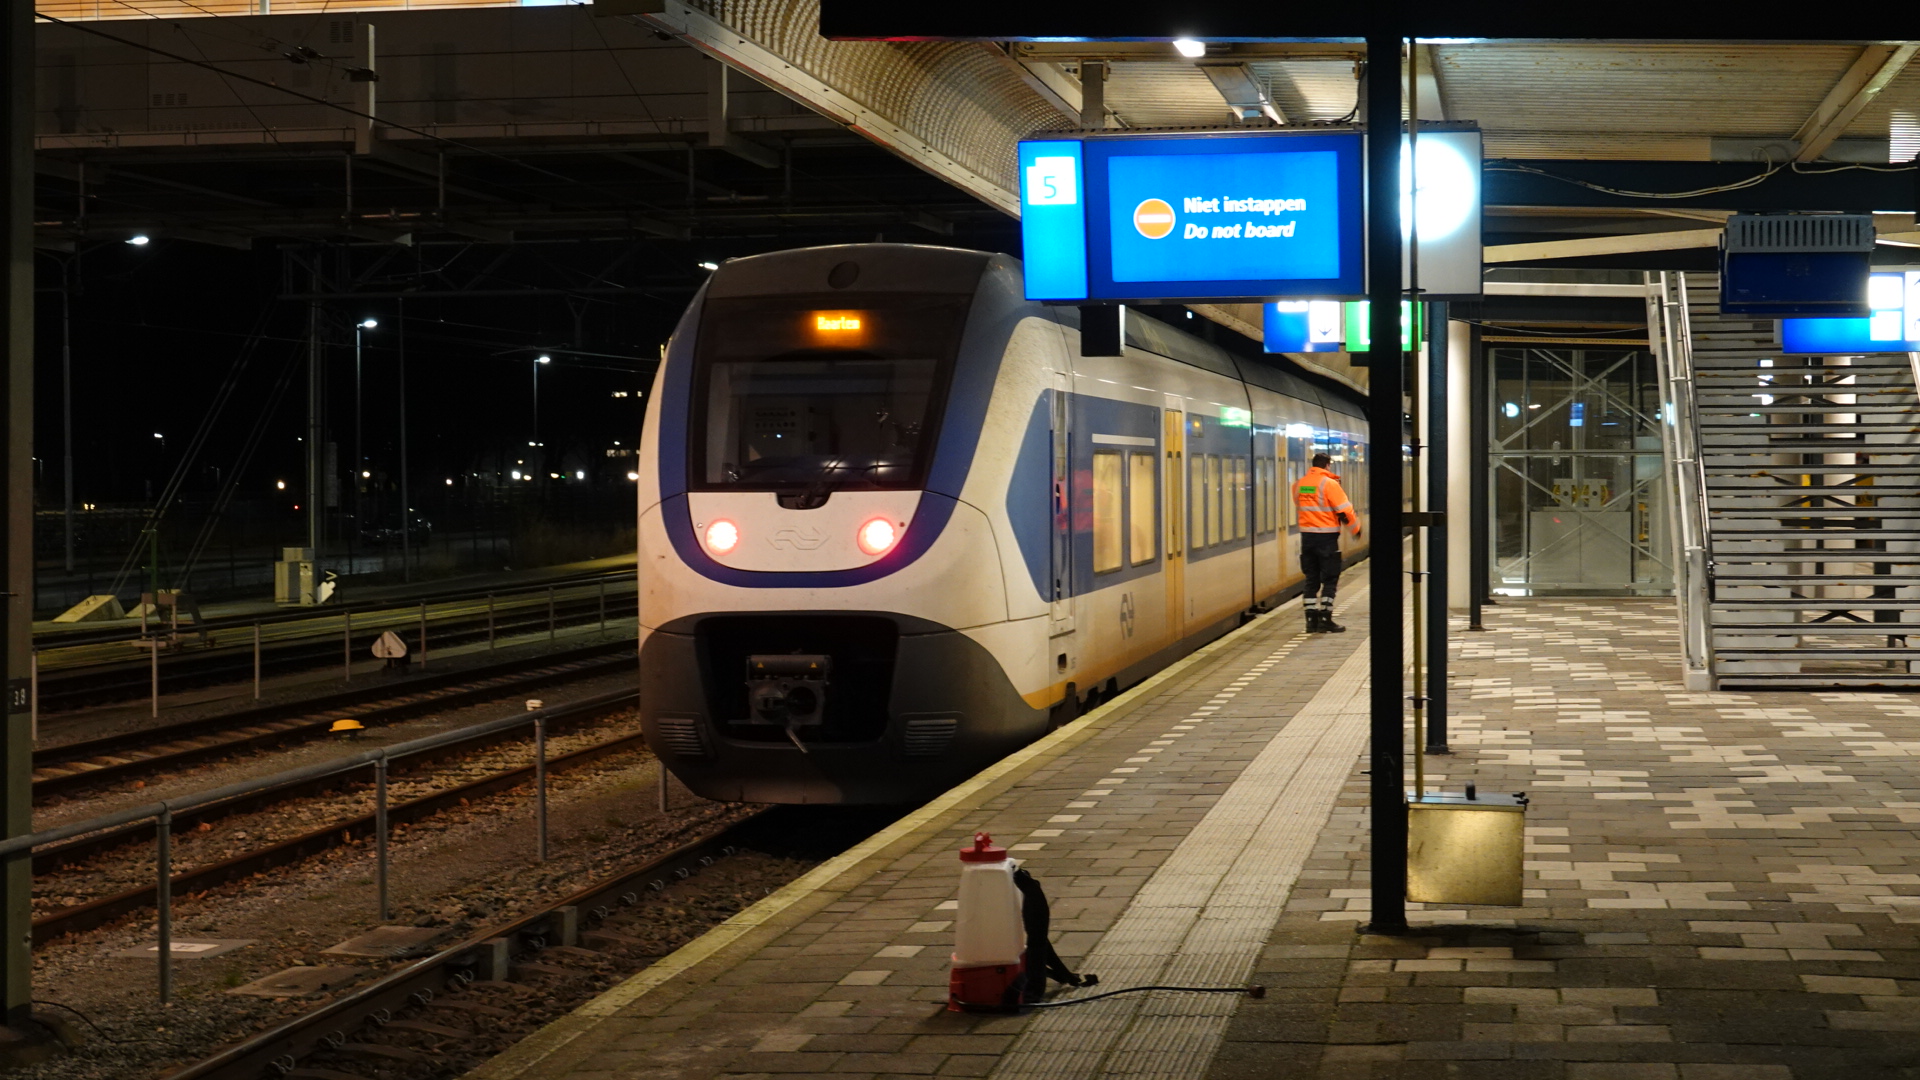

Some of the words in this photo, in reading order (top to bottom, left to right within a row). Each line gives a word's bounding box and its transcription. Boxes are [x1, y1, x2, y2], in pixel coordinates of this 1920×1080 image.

[1043, 175, 1057, 199] 5
[1183, 197, 1220, 213] Niet
[1223, 196, 1306, 216] instappen
[1183, 223, 1208, 239] Do
[1211, 224, 1242, 238] not
[1244, 221, 1296, 238] board
